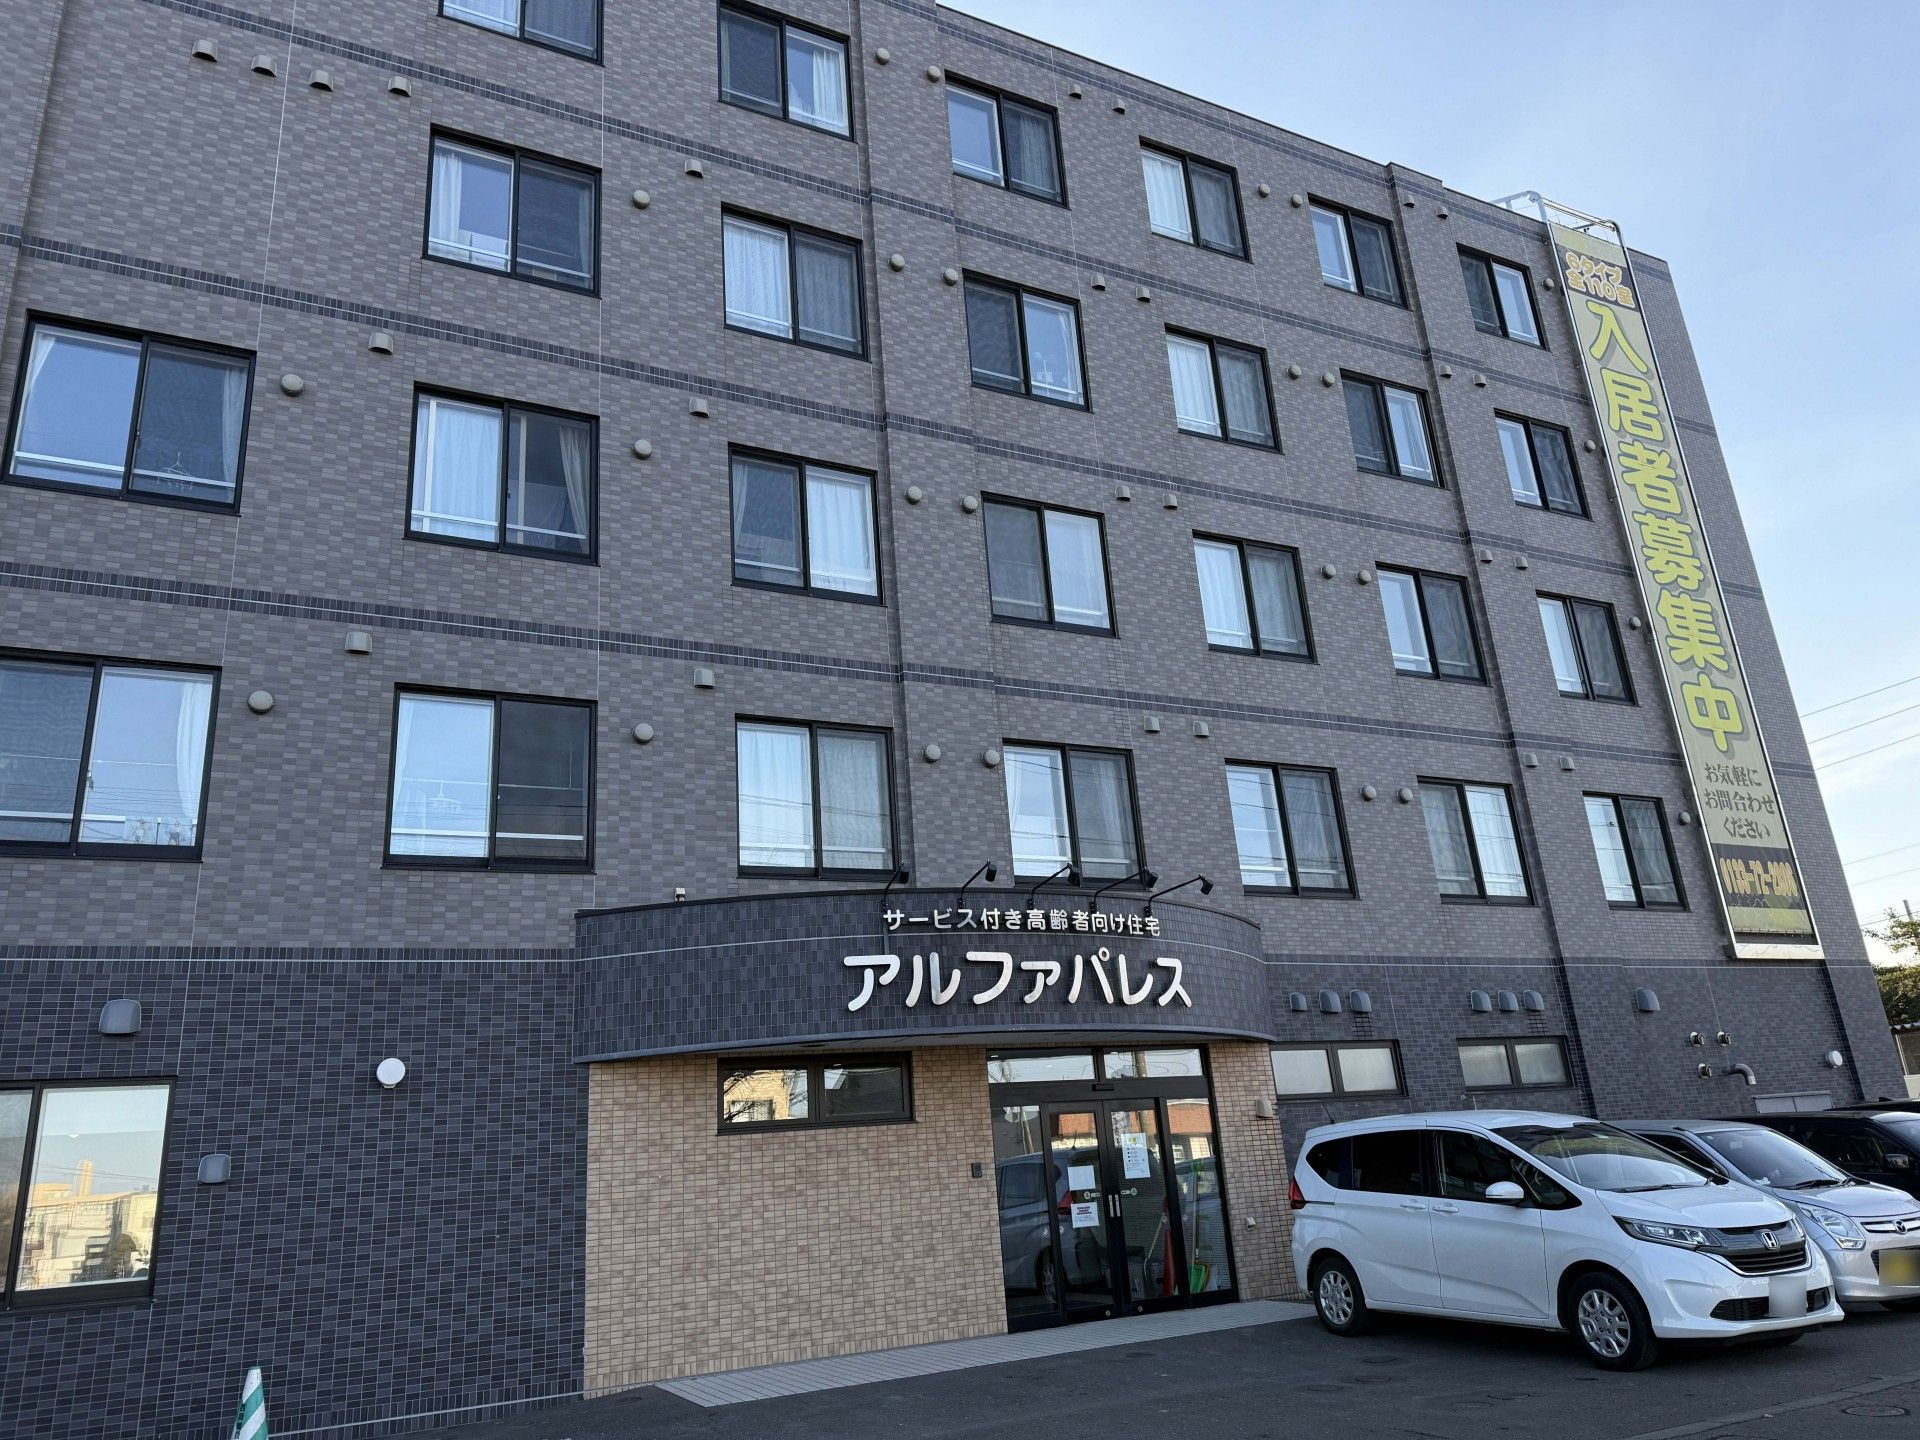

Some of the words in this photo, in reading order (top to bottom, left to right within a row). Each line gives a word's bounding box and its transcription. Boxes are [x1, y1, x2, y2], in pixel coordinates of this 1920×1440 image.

[1588, 300, 1743, 752] 入居者募集中
[1704, 763, 1762, 786] お気軽に
[1703, 788, 1775, 814] お問合わせ
[1723, 816, 1770, 839] ください
[883, 908, 1161, 937] サービス付き高齢者向け住宅
[843, 946, 1192, 1012] アルファパレス
